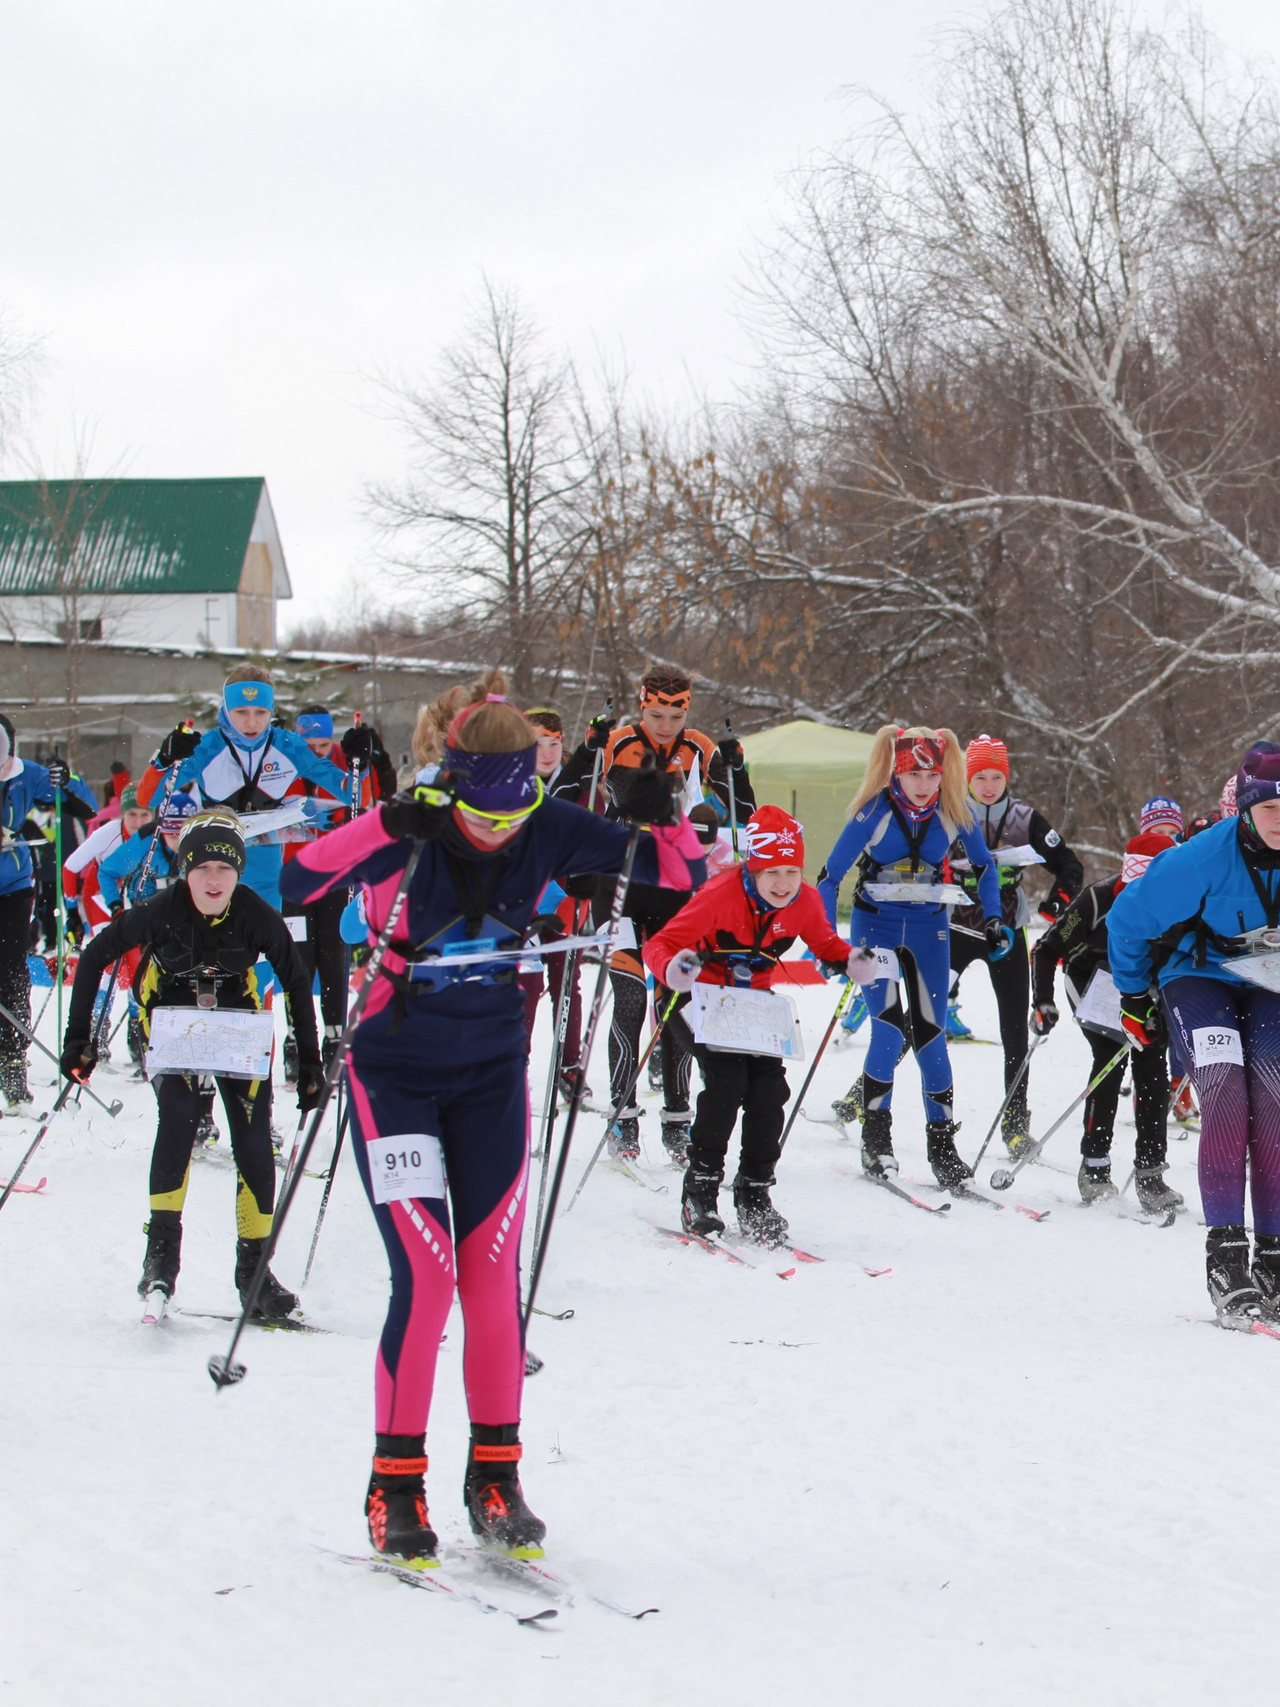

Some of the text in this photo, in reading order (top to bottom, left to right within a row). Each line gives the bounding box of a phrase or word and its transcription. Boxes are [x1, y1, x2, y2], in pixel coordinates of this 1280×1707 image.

[559, 996, 571, 1043] CROSS
[1207, 1034, 1231, 1046] 927
[385, 1150, 421, 1170] 910
